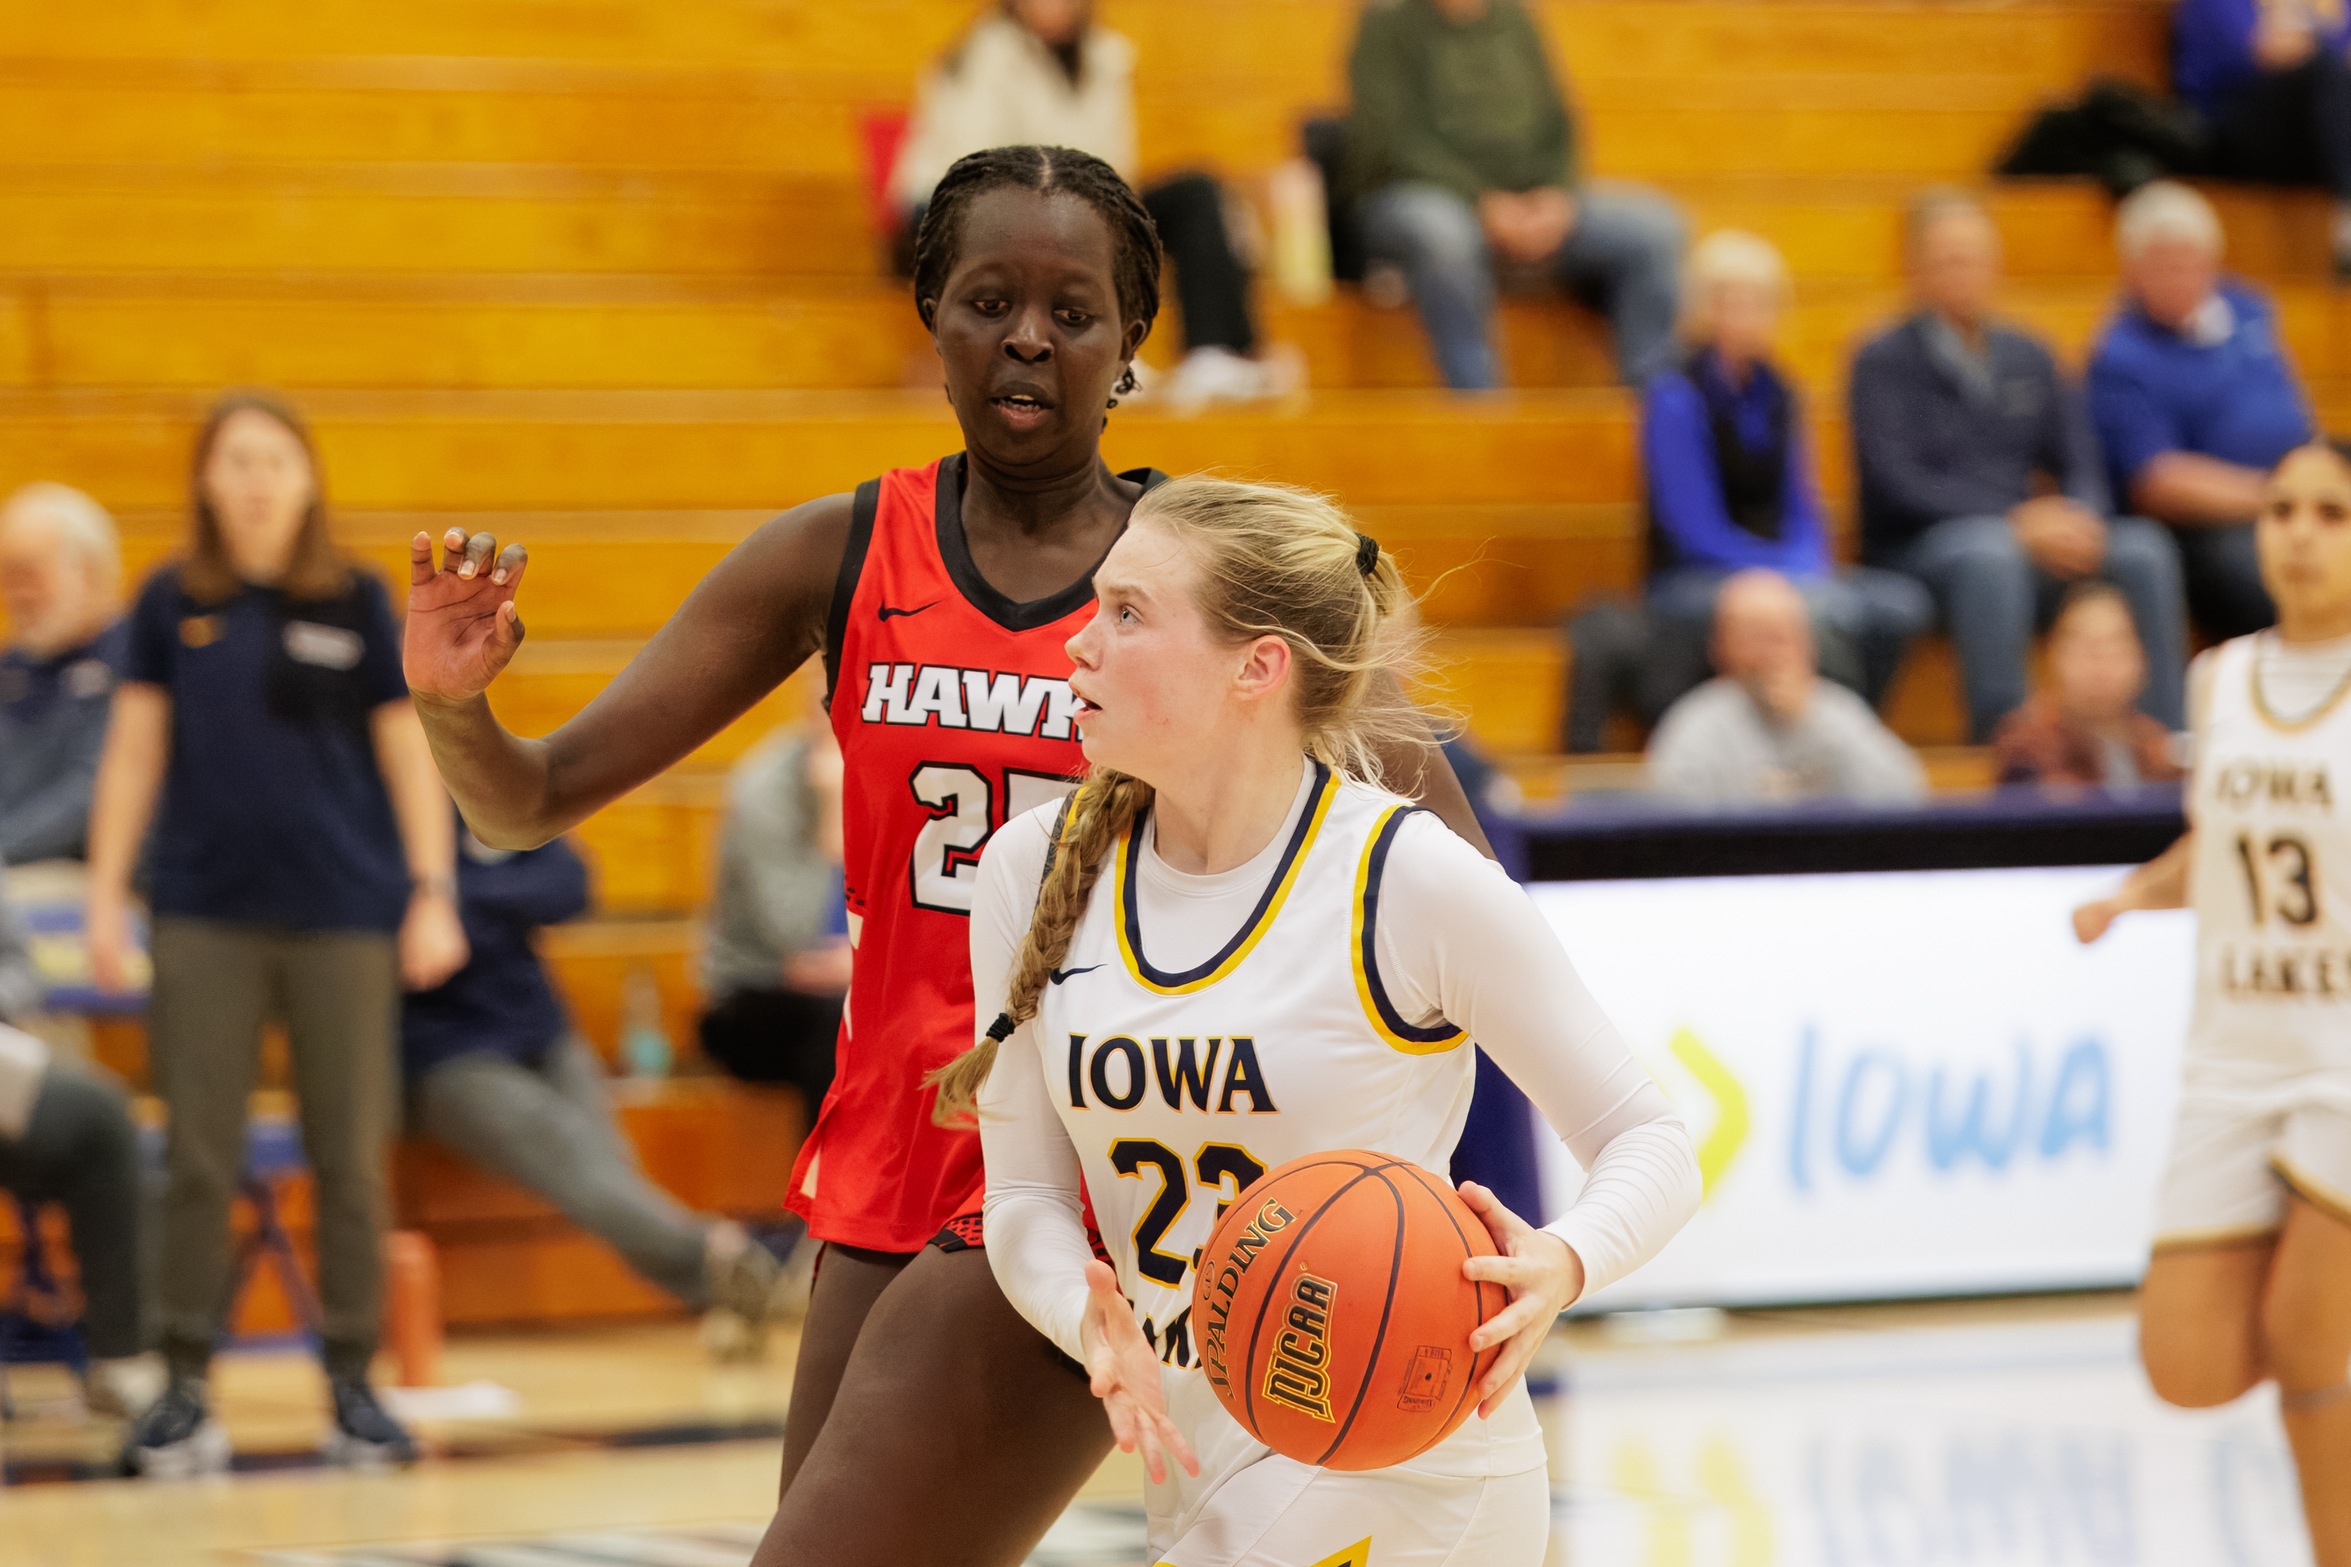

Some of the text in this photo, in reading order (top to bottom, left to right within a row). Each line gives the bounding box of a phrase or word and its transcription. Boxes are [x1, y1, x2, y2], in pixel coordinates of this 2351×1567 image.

[2216, 757, 2335, 815] IOWA
[2236, 826, 2322, 929] 13
[1068, 1032, 1281, 1115] IOWA
[1789, 1018, 2116, 1194] IOWA
[1207, 1197, 1297, 1400] SPALDING
